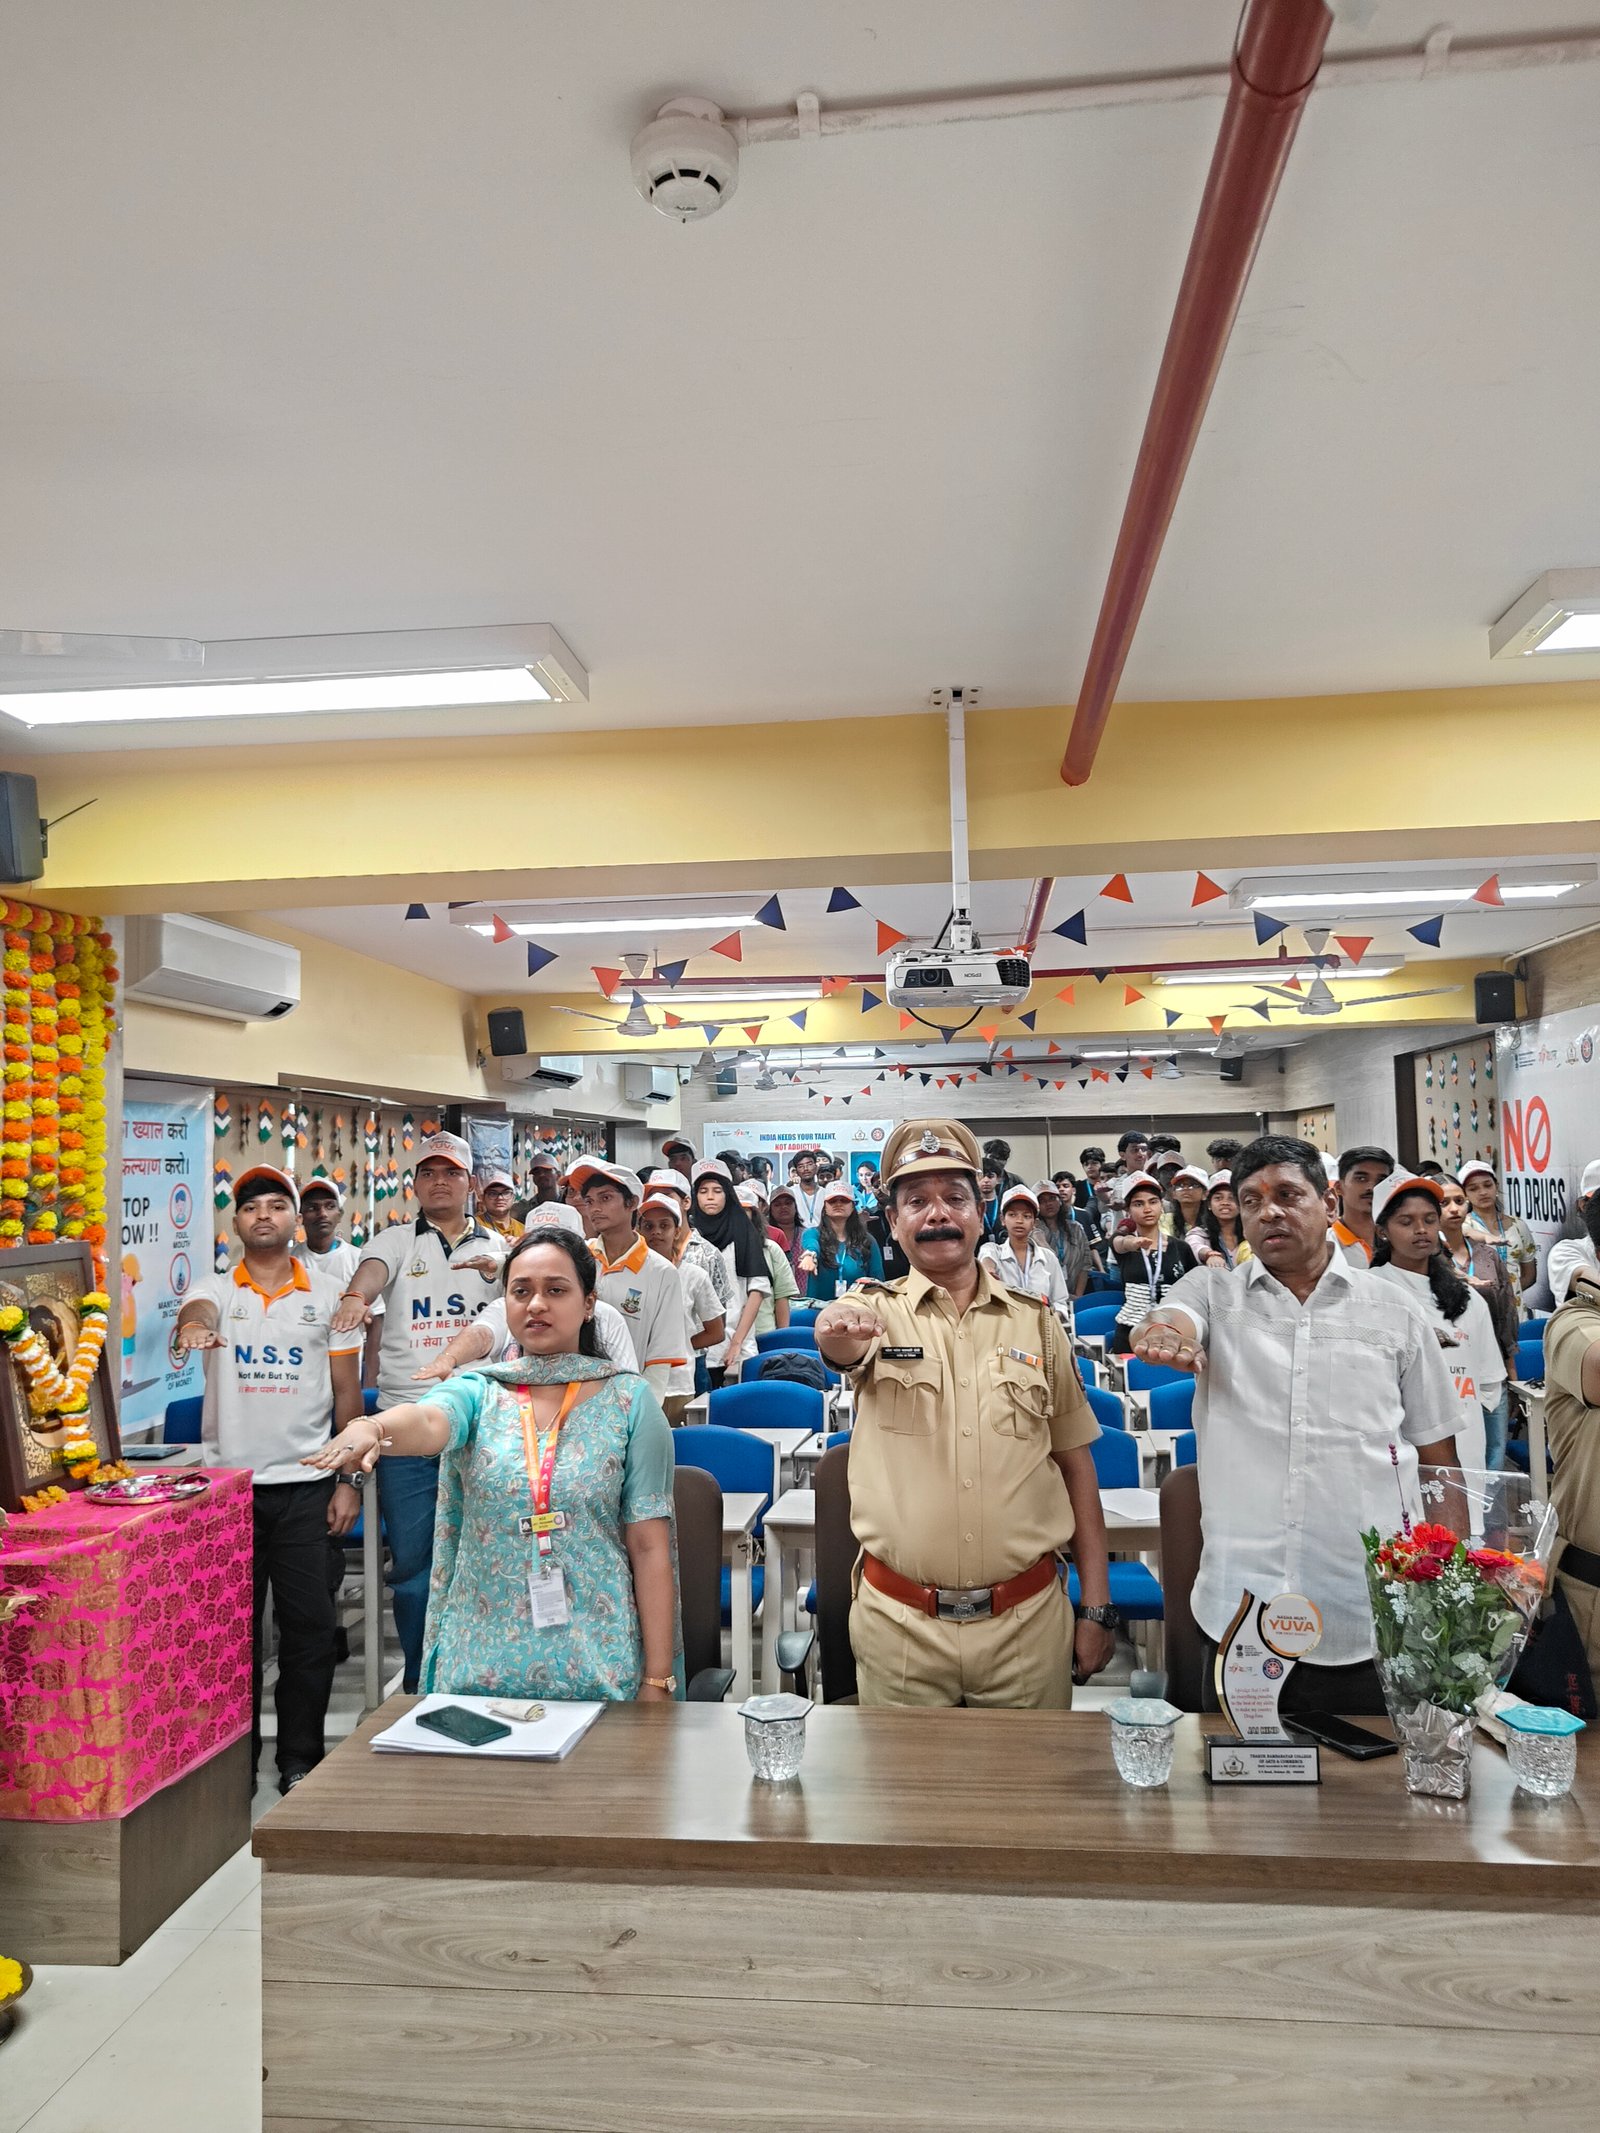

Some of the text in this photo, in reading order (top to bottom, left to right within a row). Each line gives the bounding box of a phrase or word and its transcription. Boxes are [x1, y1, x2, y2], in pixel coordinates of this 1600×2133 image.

[167, 1117, 188, 1140] करो
[759, 1133, 776, 1141] INDIA
[778, 1133, 796, 1141] NEEDS
[814, 1132, 836, 1140] TALENT,
[1502, 1095, 1552, 1174] NO
[788, 1142, 821, 1151] ADDICTION
[1506, 1177, 1567, 1225] TO DRUGS
[532, 1216, 560, 1224] YUVA
[411, 1322, 432, 1332] NOT
[436, 1320, 450, 1329] ME
[238, 1372, 299, 1380] Not Me But You
[1268, 1619, 1316, 1632] YUVA
[1260, 1726, 1280, 1734] HIND
